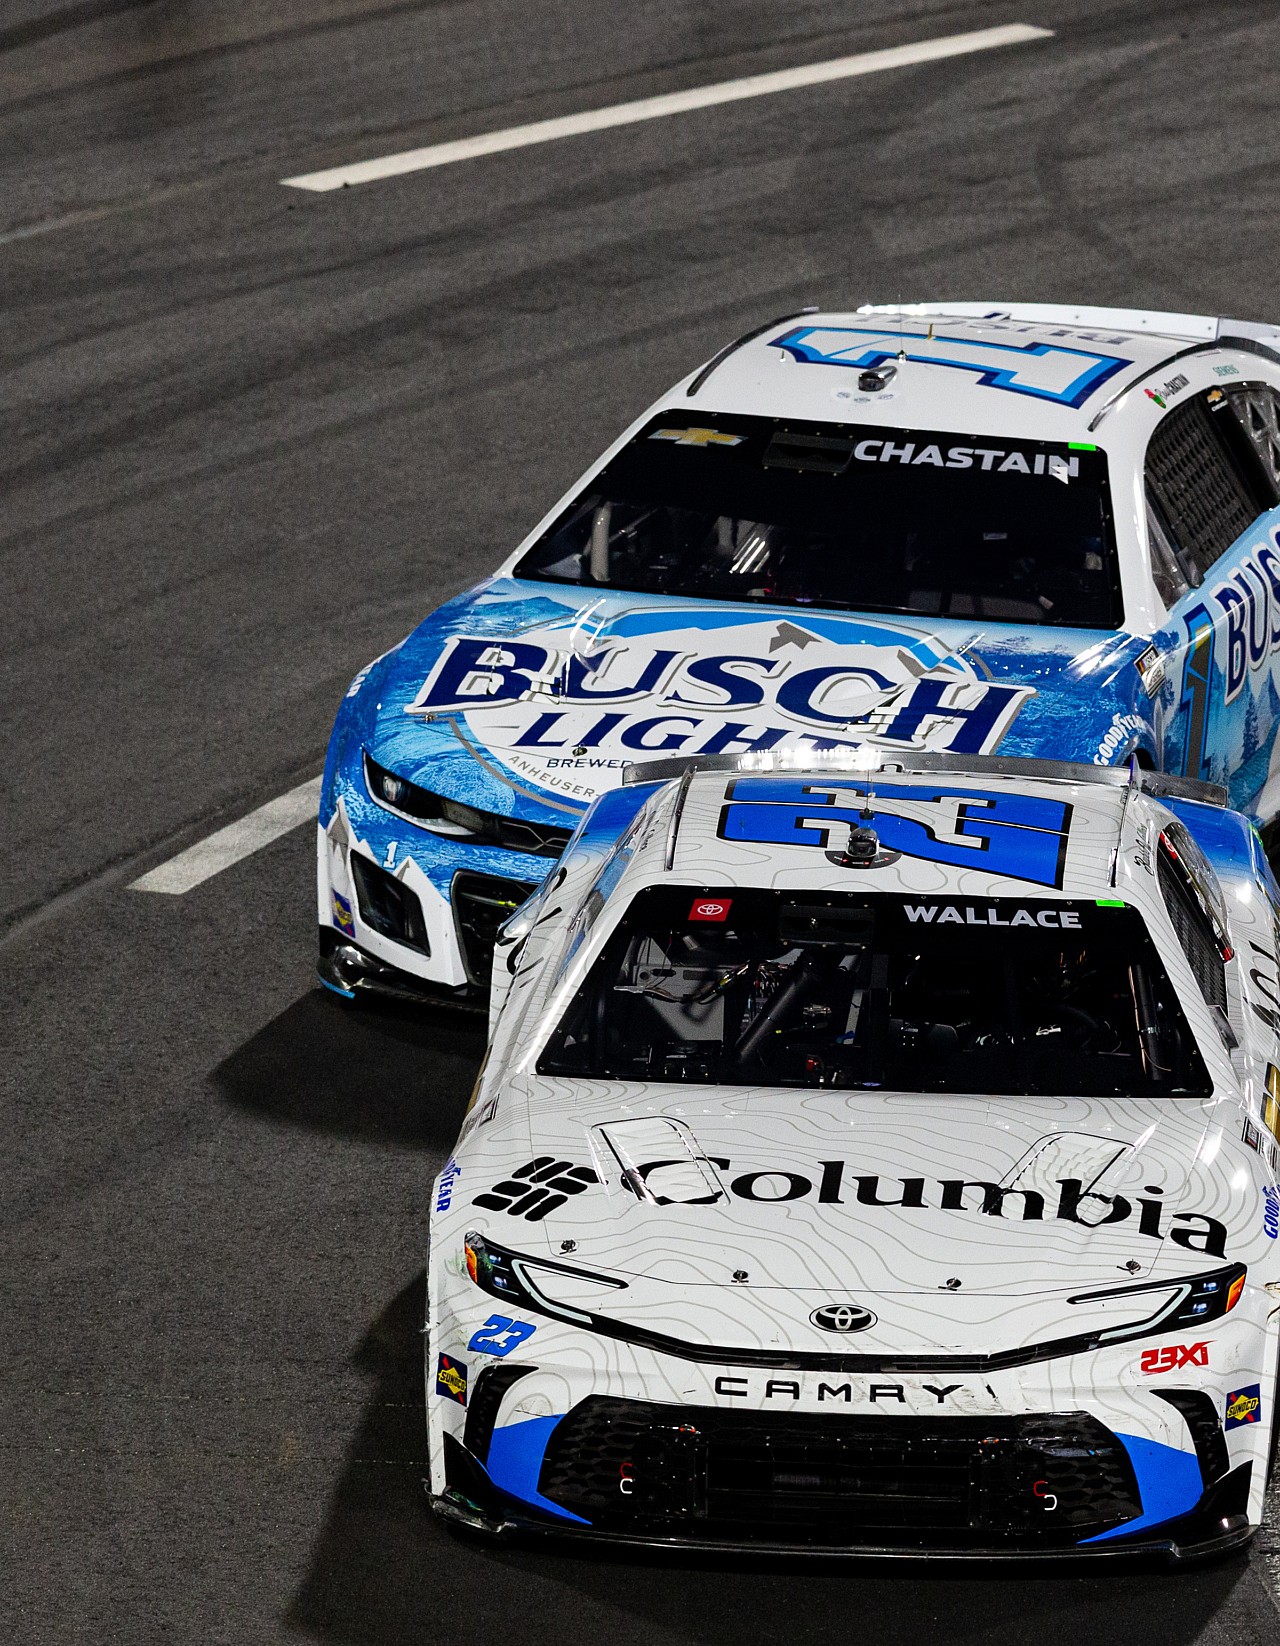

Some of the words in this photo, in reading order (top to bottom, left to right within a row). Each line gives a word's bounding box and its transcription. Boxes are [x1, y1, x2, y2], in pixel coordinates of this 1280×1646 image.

[854, 439, 1079, 479] CHASTAIN
[428, 635, 1024, 753] BUSCH
[382, 841, 398, 869] 1
[903, 904, 1082, 930] WALLACE
[620, 1157, 1229, 1261] Columbia
[466, 1313, 537, 1358] 23
[440, 1371, 466, 1391] SUNOCO
[714, 1376, 965, 1404] CAMRY
[1227, 1398, 1259, 1418] SUNOCO
